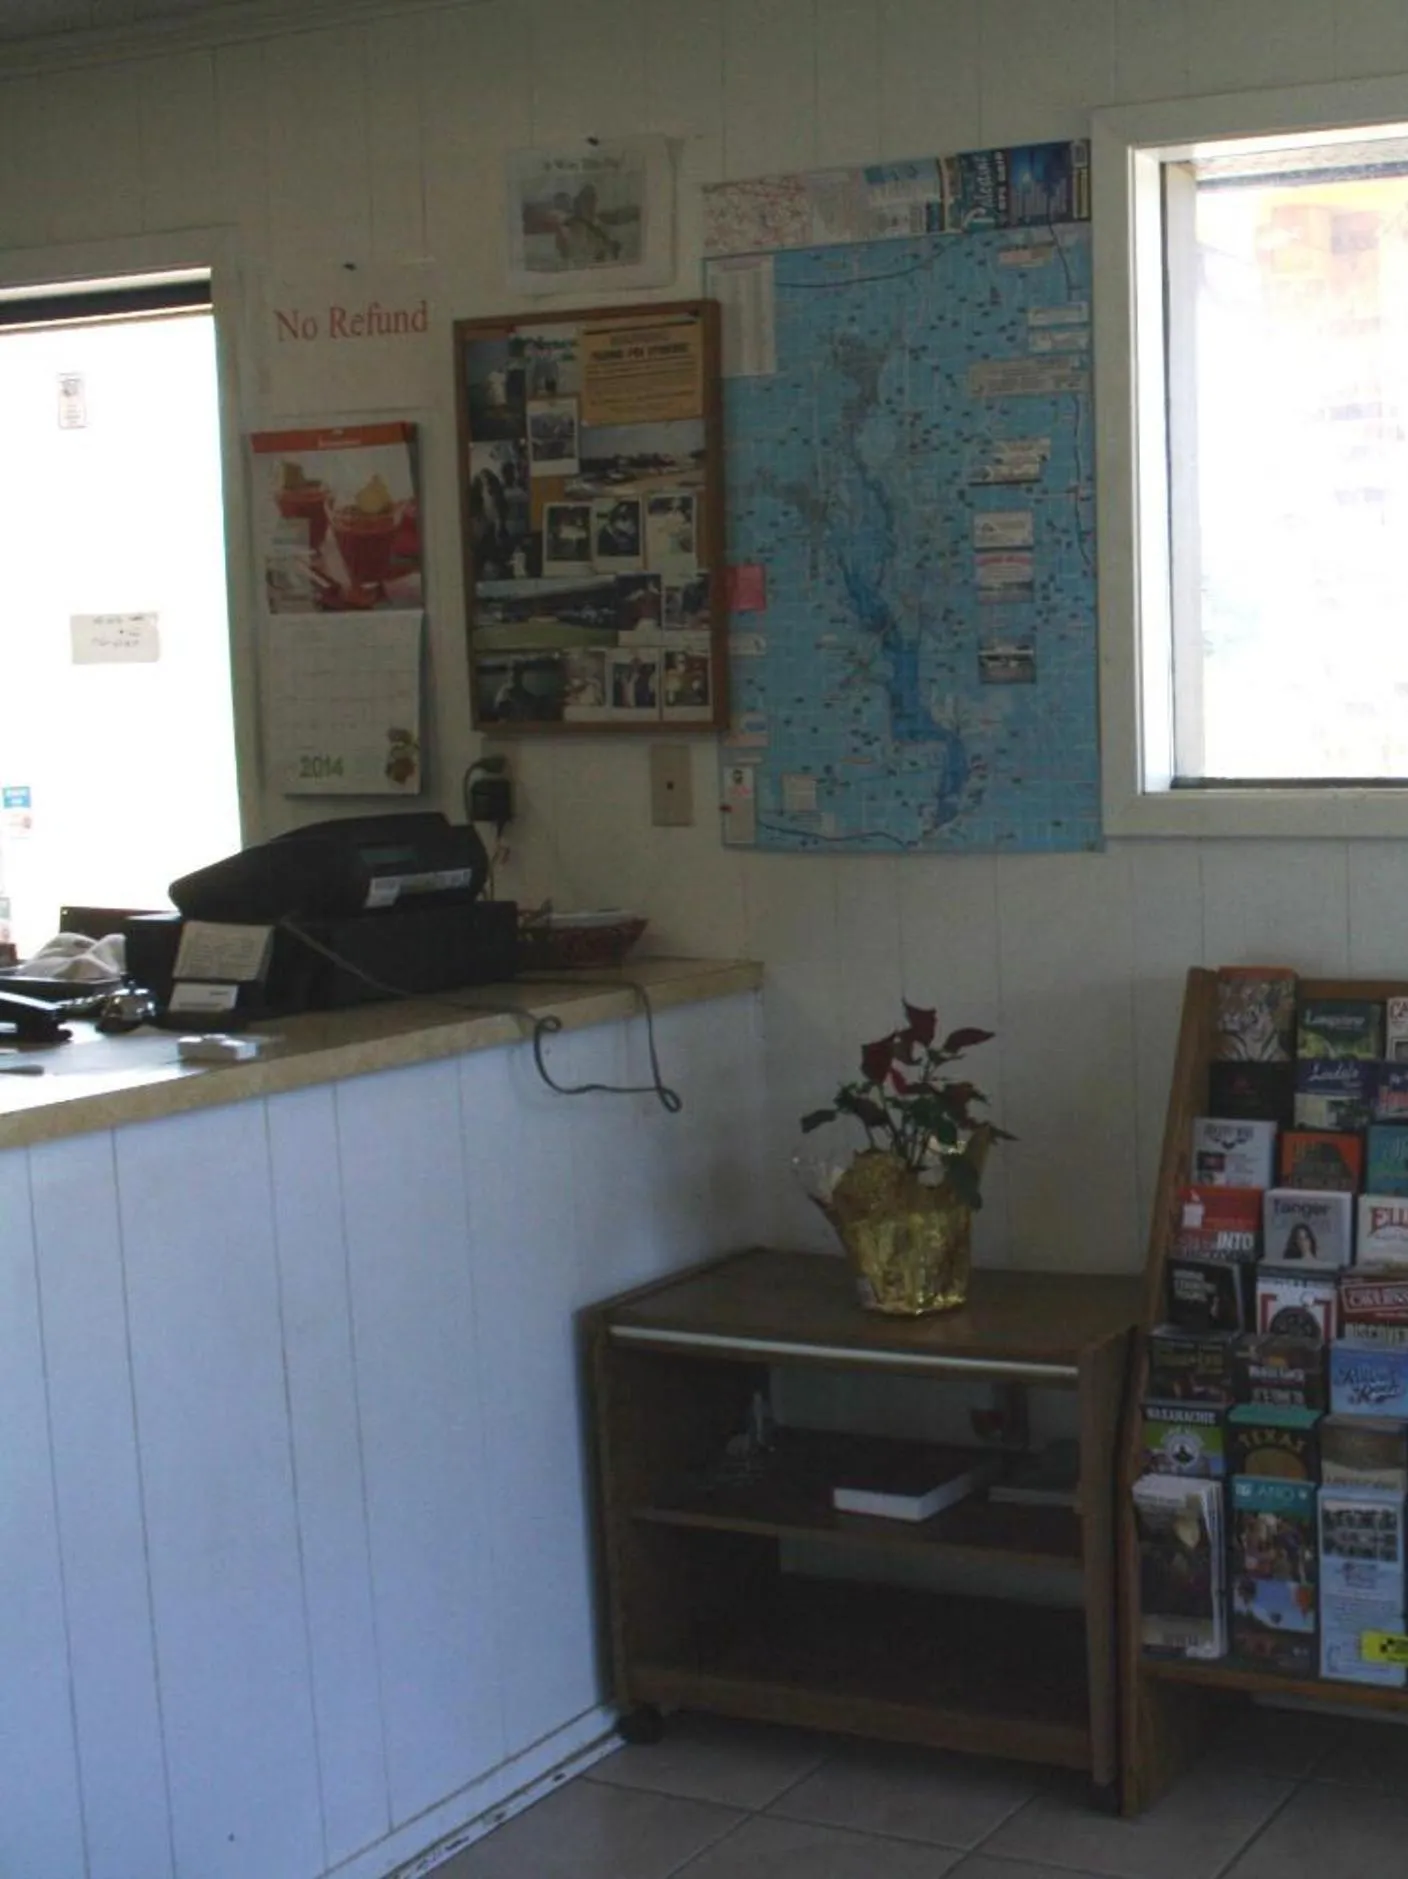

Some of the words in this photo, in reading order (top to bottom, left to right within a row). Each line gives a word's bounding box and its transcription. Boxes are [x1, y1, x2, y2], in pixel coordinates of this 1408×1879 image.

[275, 310, 319, 342] No
[328, 301, 430, 340] Refund
[300, 755, 345, 779] 2014
[1216, 1231, 1254, 1251] INTO
